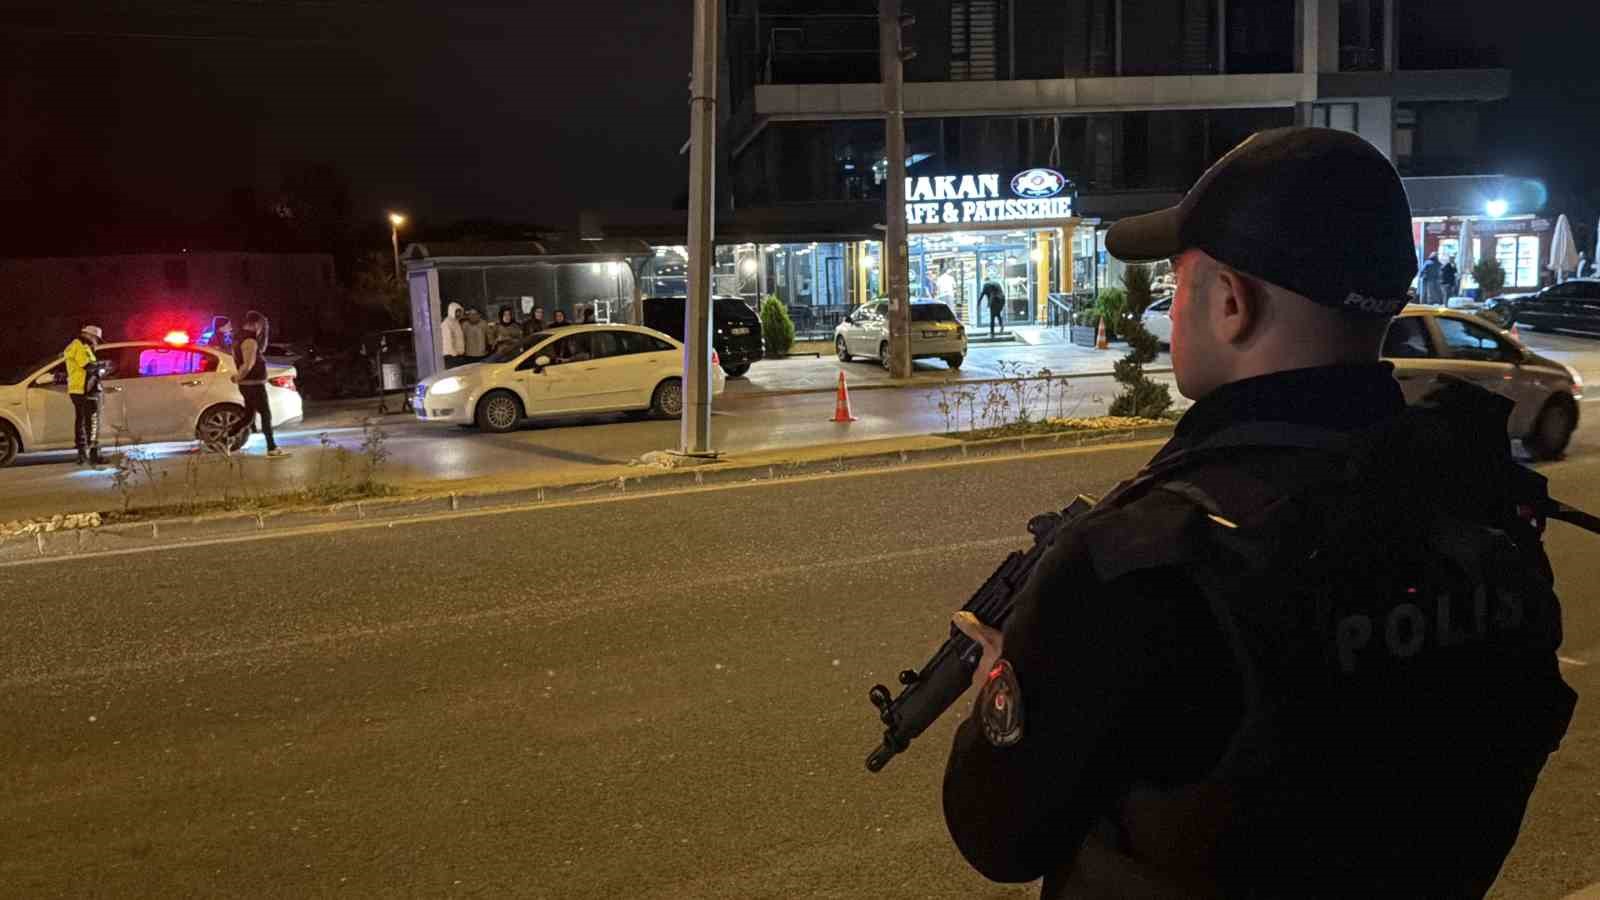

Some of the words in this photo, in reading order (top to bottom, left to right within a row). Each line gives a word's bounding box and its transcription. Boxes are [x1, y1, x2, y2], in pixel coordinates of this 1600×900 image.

[905, 203, 939, 224] AFE
[943, 202, 959, 223] &
[962, 197, 1072, 222] PATISSERIE
